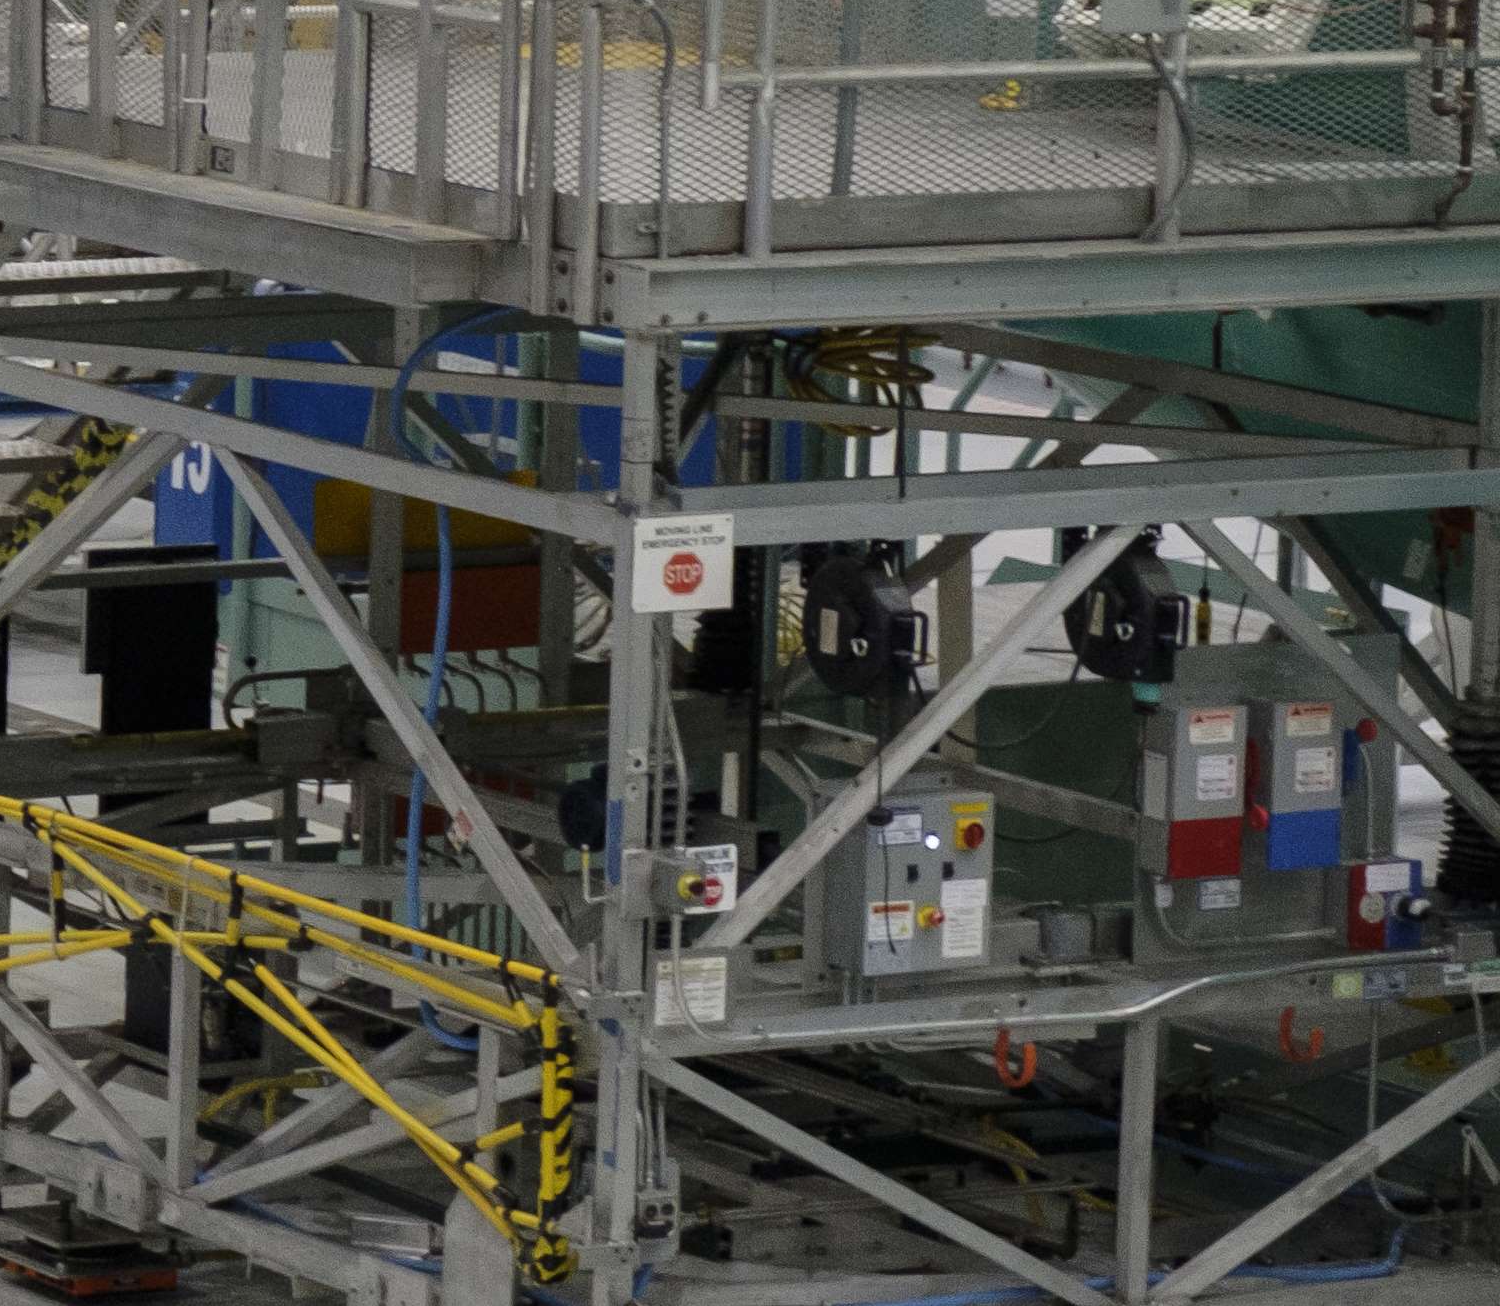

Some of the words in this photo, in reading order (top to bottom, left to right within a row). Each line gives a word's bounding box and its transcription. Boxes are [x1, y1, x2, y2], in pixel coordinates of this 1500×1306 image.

[655, 525, 691, 536] MOVING
[693, 523, 713, 534] LINE
[641, 537, 699, 550] EMERGENCY
[701, 535, 726, 546] STOP
[665, 563, 702, 584] STOP
